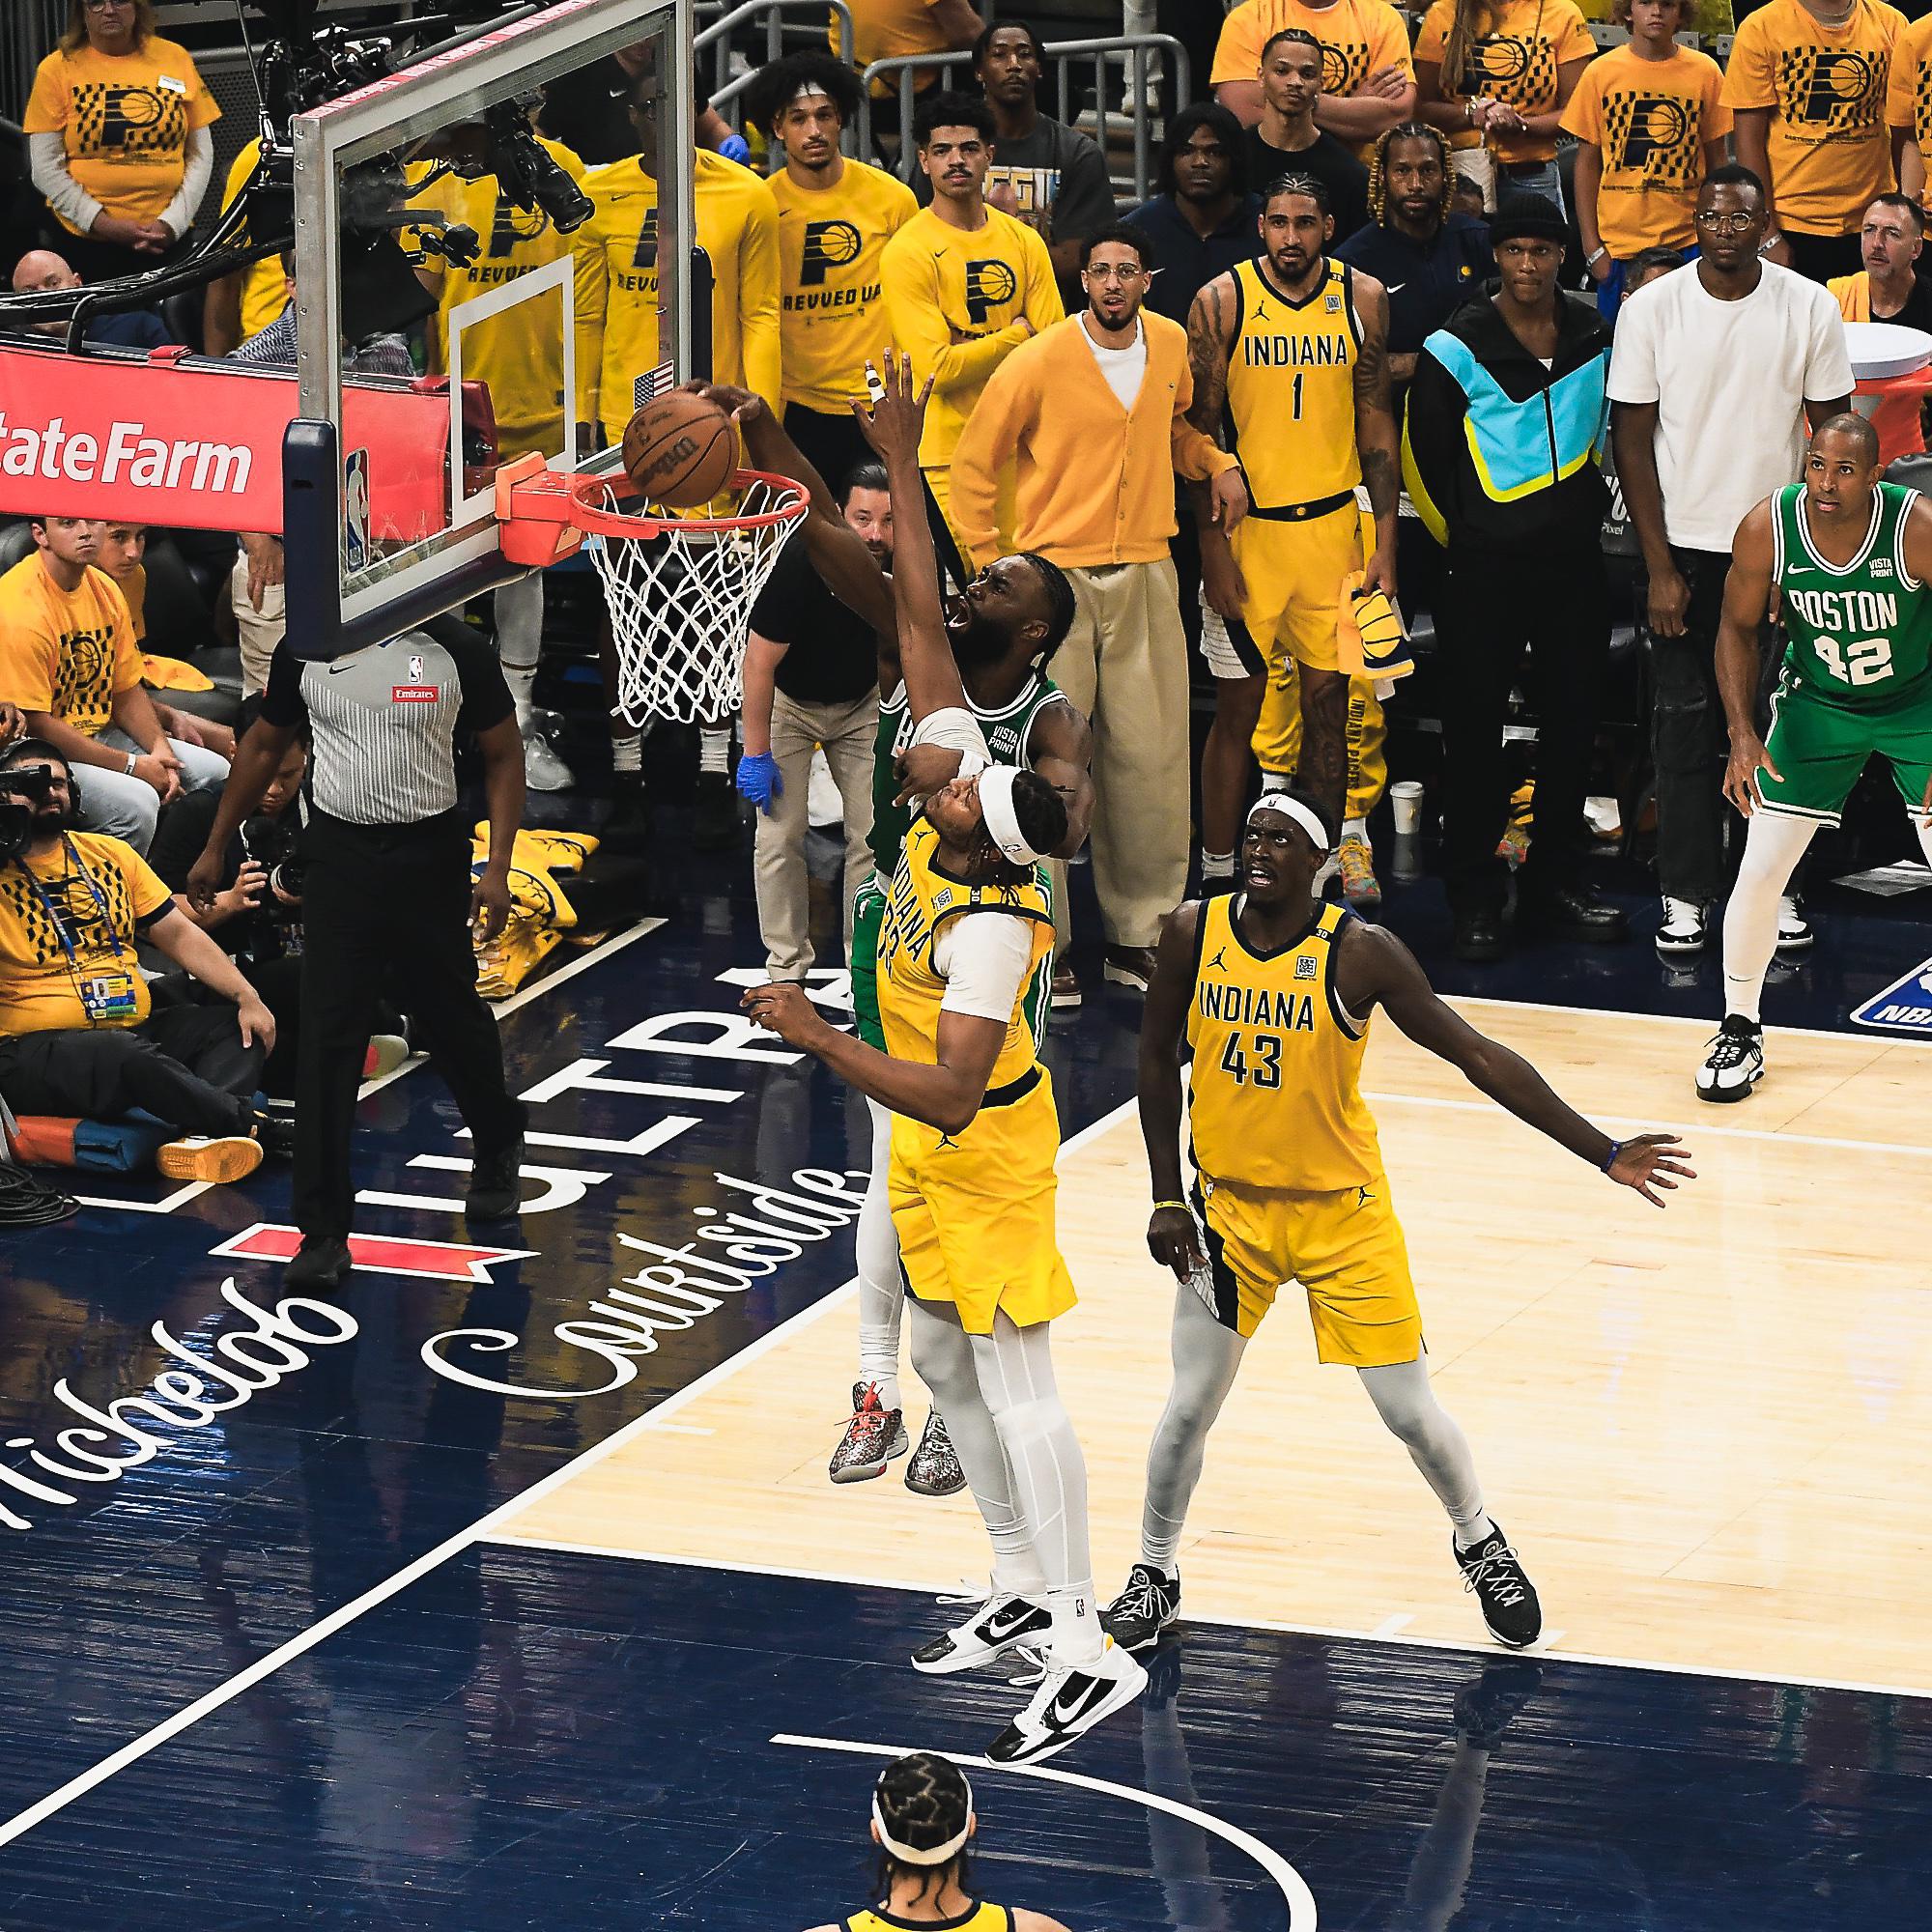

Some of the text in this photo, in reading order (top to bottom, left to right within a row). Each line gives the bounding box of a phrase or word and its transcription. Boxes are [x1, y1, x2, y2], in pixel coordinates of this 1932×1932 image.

[783, 288, 857, 311] REVVED
[1243, 334, 1349, 367] INDIANA
[1291, 371, 1304, 422] 1
[100, 421, 253, 494] Farm
[1869, 557, 1893, 570] VISTA
[1870, 570, 1893, 579] PRINT
[1788, 589, 1898, 633] BOSTON
[1813, 635, 1894, 686] 42
[396, 689, 435, 699] Emirates
[987, 736, 1015, 754] PRINT
[992, 724, 1018, 747] VISTA
[971, 890, 980, 902] 30
[1316, 928, 1328, 939] 30
[1199, 980, 1315, 1034] INDIANA
[1220, 1030, 1284, 1091] 43
